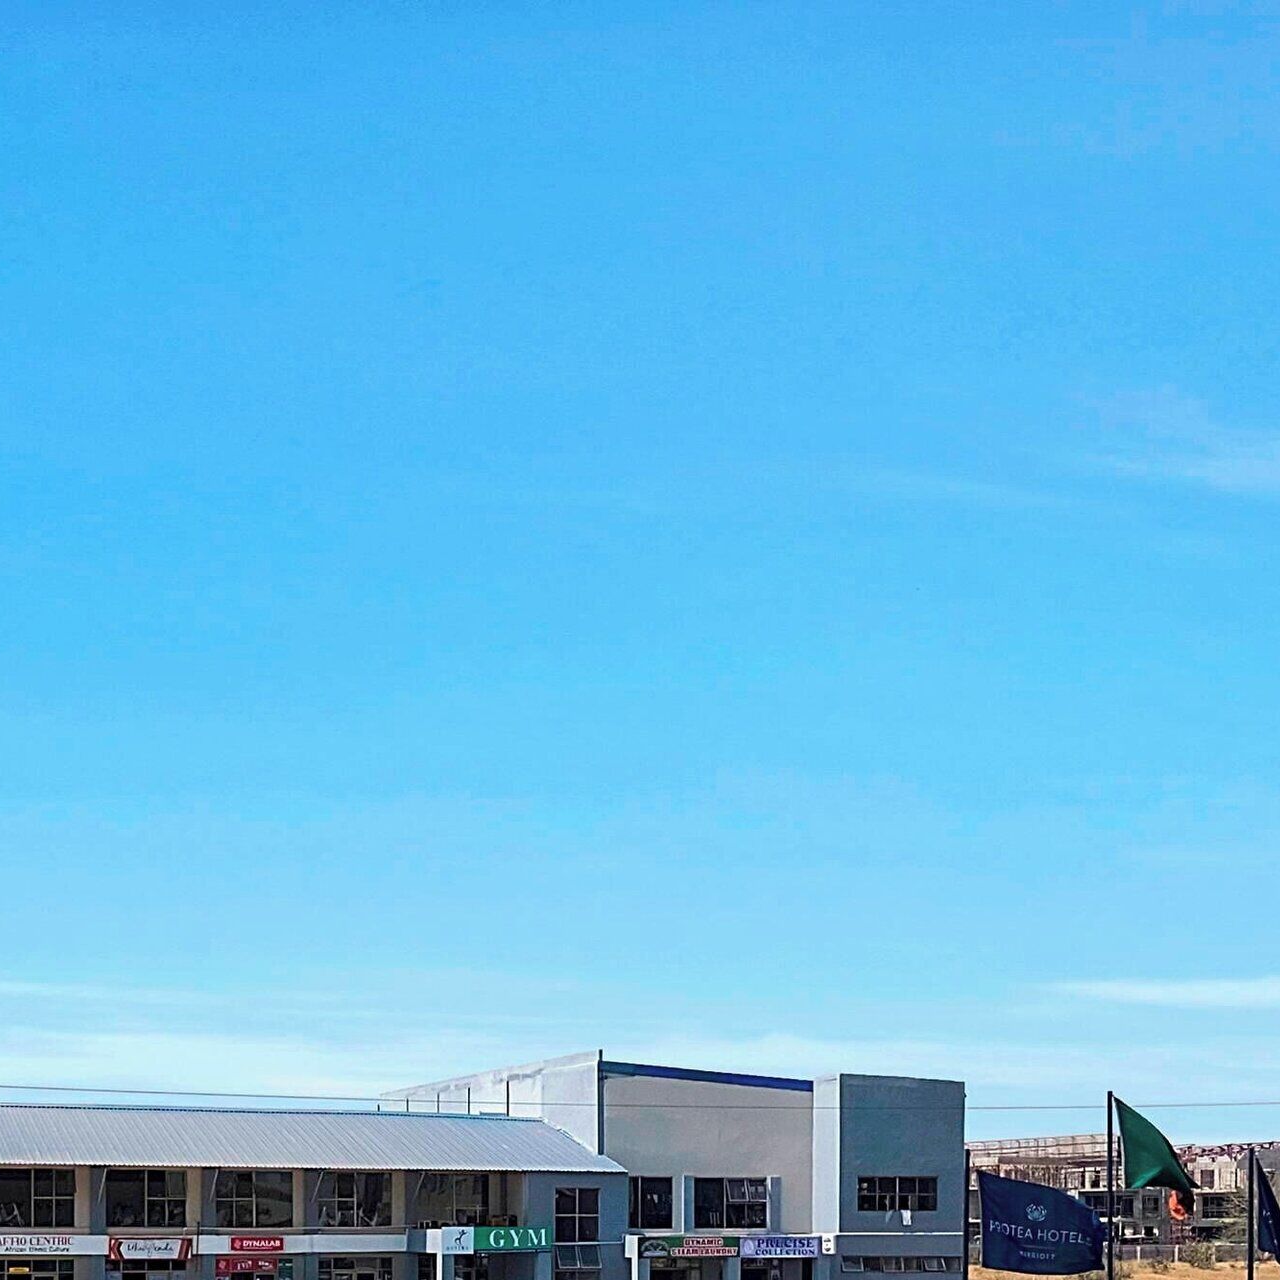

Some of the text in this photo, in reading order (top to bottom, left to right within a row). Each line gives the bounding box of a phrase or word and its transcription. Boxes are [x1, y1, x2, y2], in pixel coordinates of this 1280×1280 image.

[989, 1219, 1033, 1239] PROTEA
[29, 1236, 74, 1246] CENTRIC
[242, 1239, 281, 1247] DYNALAB
[489, 1228, 547, 1248] GYM
[684, 1238, 723, 1246] DYNAMIC
[757, 1238, 814, 1248] PRECISE
[755, 1248, 815, 1256] COLLECTION
